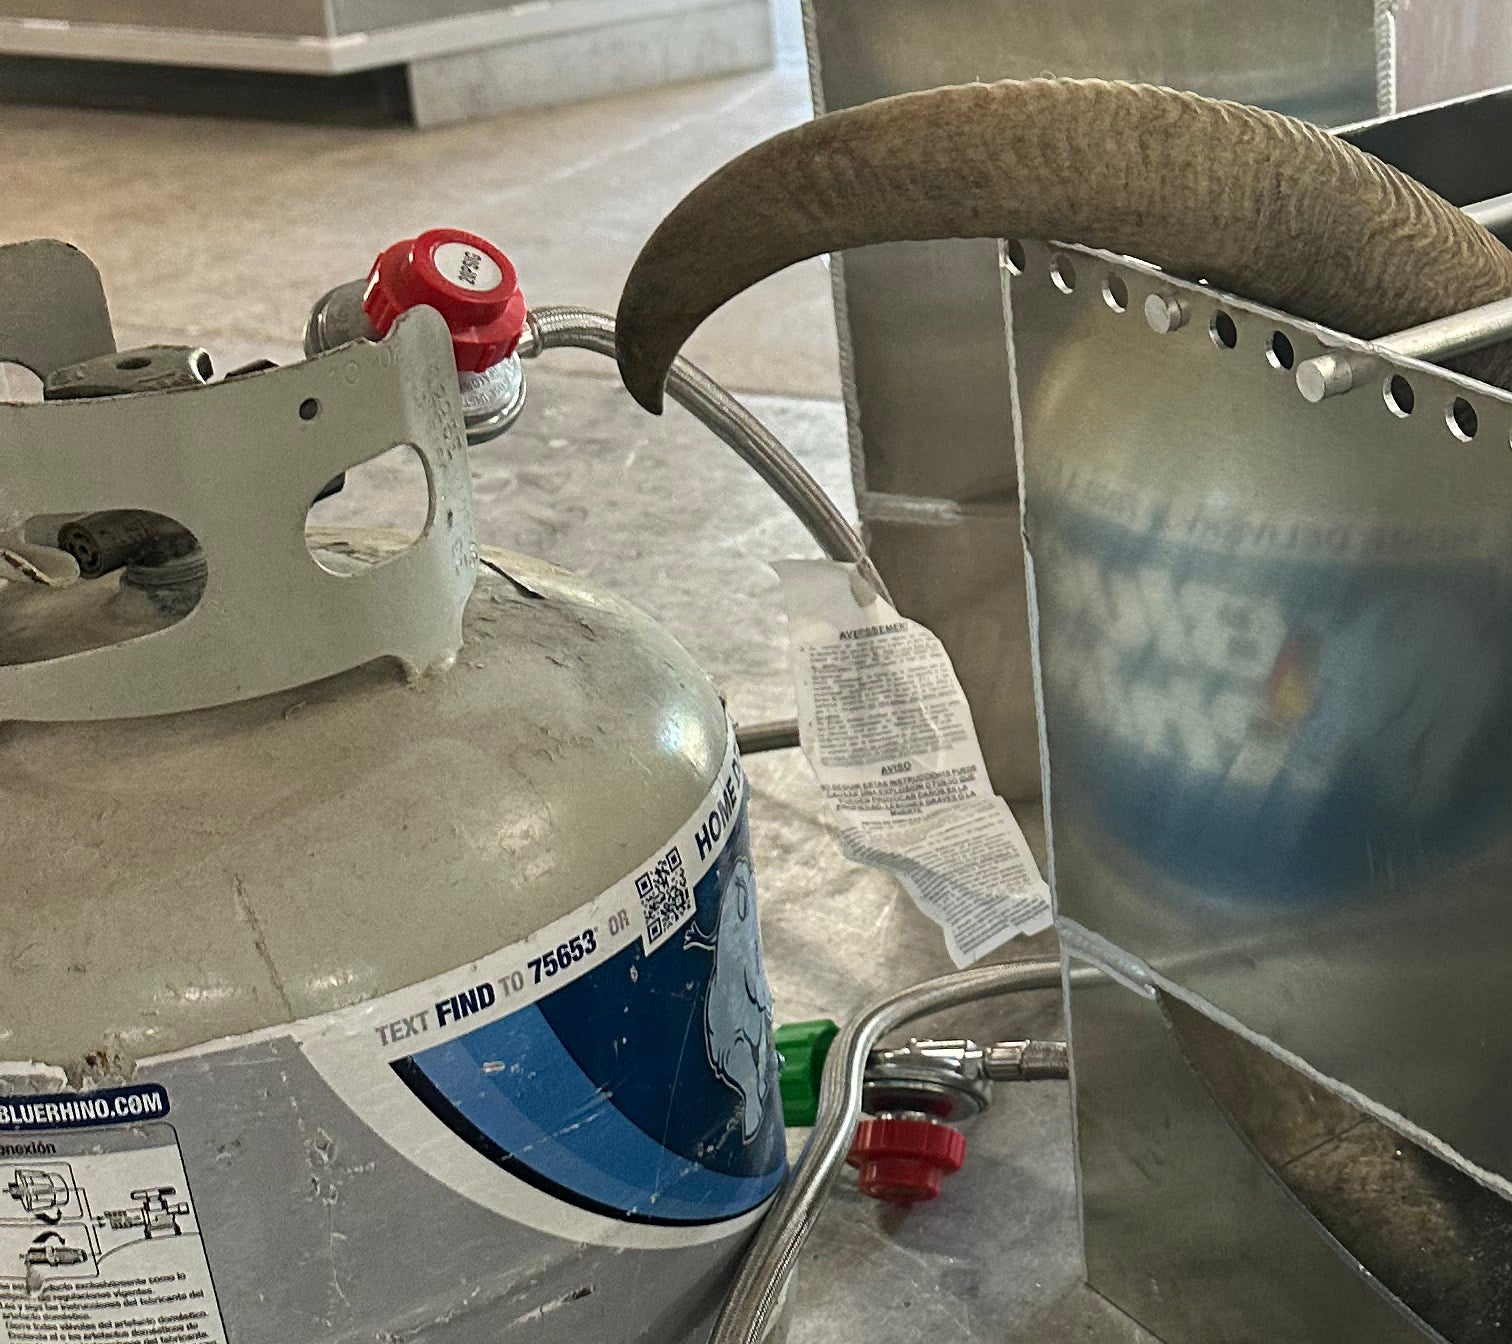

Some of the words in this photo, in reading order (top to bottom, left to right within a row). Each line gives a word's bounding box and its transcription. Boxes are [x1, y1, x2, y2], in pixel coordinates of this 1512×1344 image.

[881, 761, 911, 776] AVISO
[375, 1010, 430, 1047] TEXT
[435, 982, 496, 1028] FIND
[498, 970, 525, 998] TO
[608, 909, 629, 936] OR
[694, 775, 737, 862] HOME
[0, 1092, 163, 1124] BLUERHINO.COM
[0, 1140, 57, 1156] onexión
